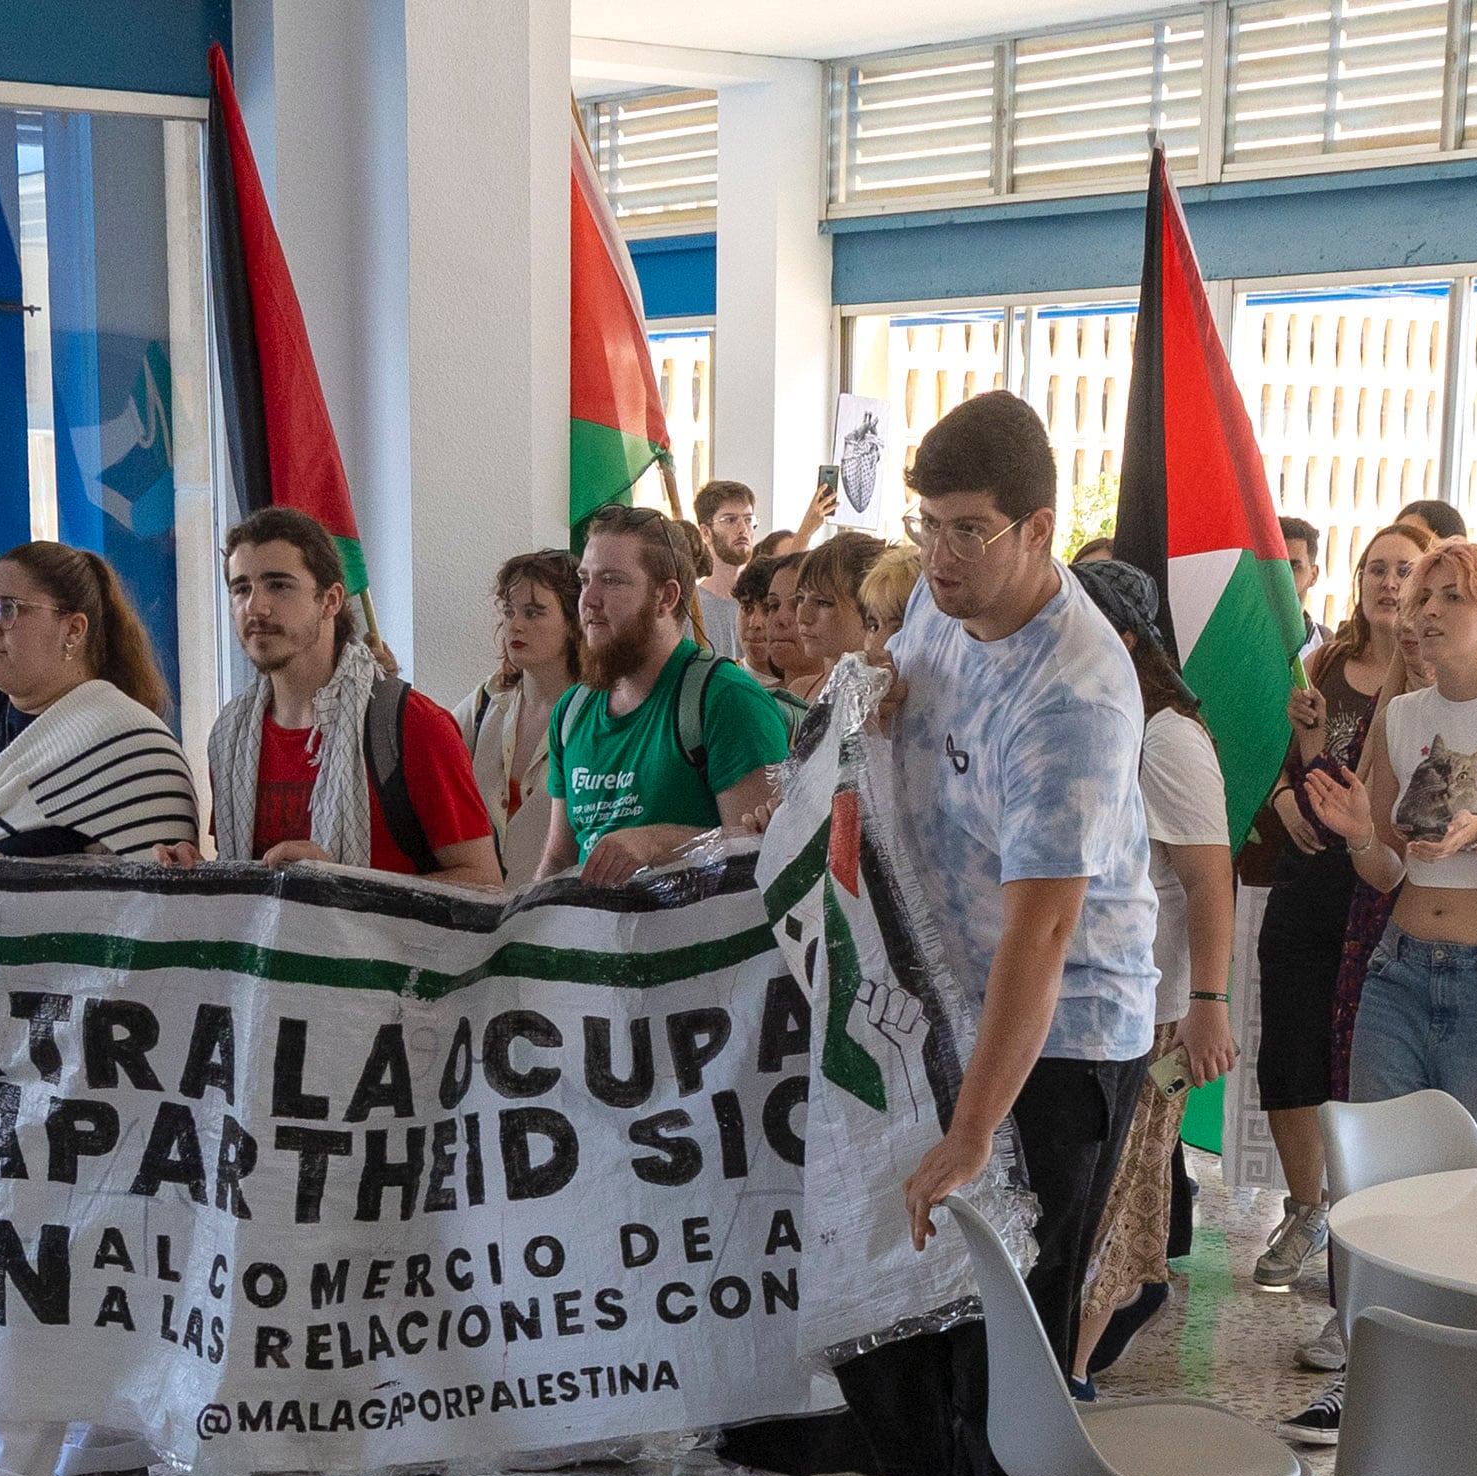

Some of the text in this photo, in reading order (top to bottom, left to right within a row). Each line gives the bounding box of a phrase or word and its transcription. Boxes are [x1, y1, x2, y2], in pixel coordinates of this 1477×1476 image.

[571, 767, 636, 791] Eureka
[271, 1017, 413, 1124] LA
[93, 1227, 182, 1283] AL
[209, 1236, 566, 1311] COMERCIO
[620, 1216, 713, 1269] DE
[95, 1267, 800, 1373] A LAS RELACIONES CON
